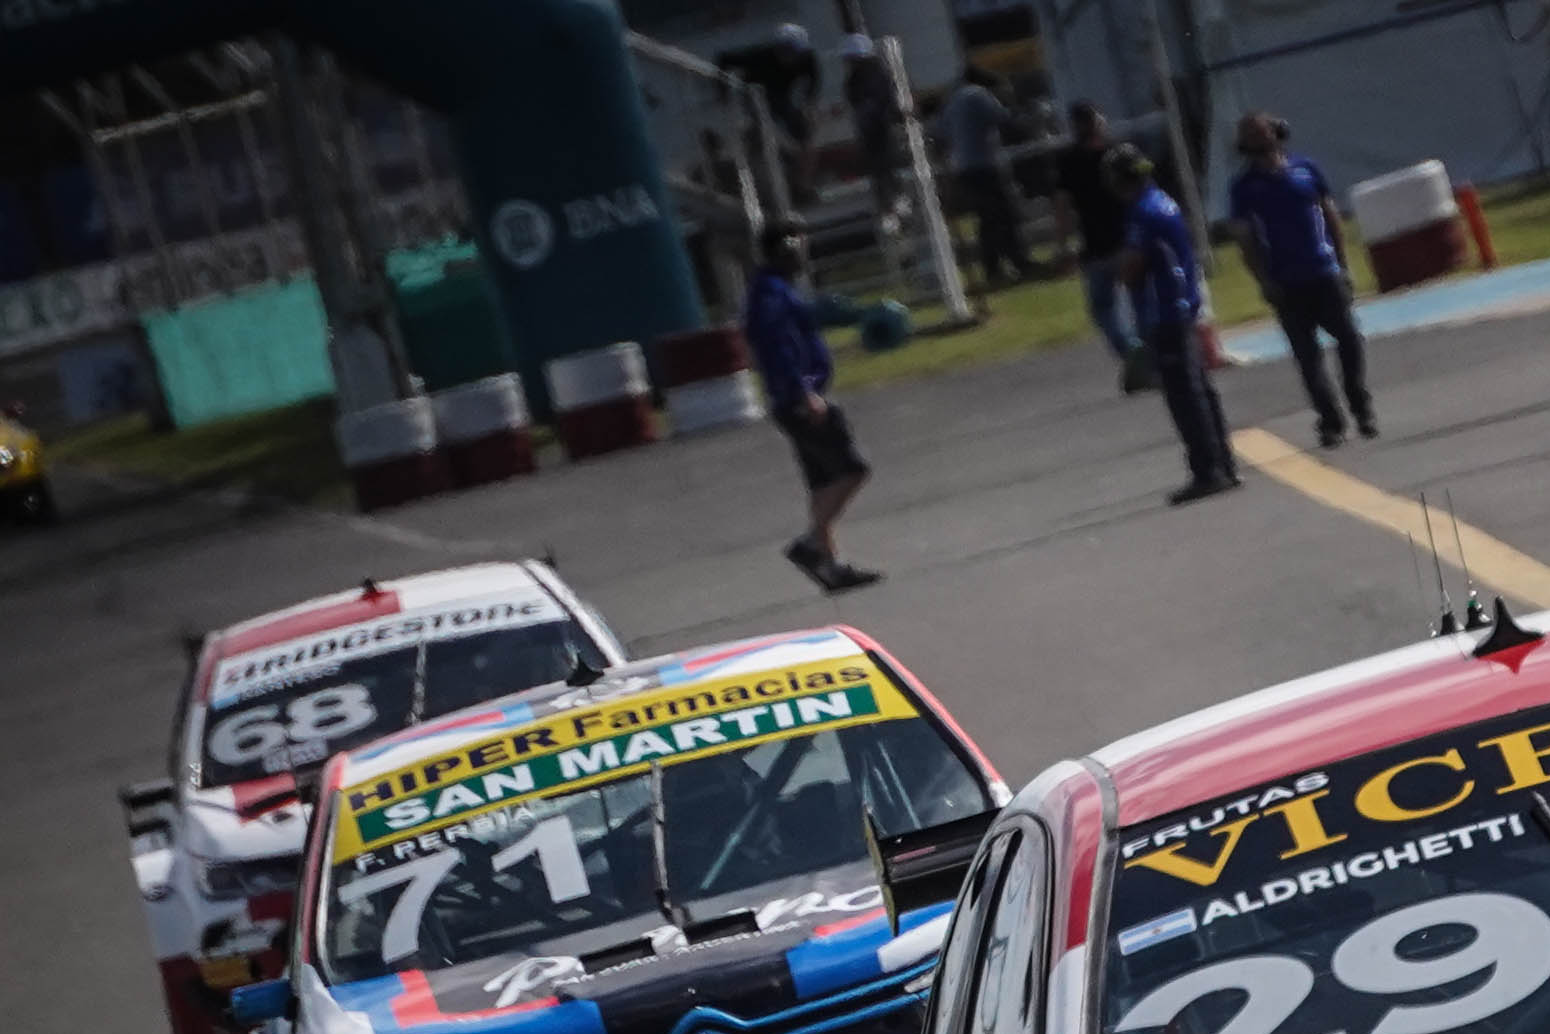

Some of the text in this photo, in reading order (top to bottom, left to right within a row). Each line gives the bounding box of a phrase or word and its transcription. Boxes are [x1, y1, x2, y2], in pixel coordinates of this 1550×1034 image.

[209, 682, 377, 767] 68
[349, 727, 558, 810] HIPER
[571, 664, 870, 738] Farmacias
[384, 690, 854, 830] SAN MARTIN
[1122, 772, 1330, 859] FRUTAS
[1201, 812, 1526, 927] ALDRIGHETTI
[337, 815, 591, 964] 71
